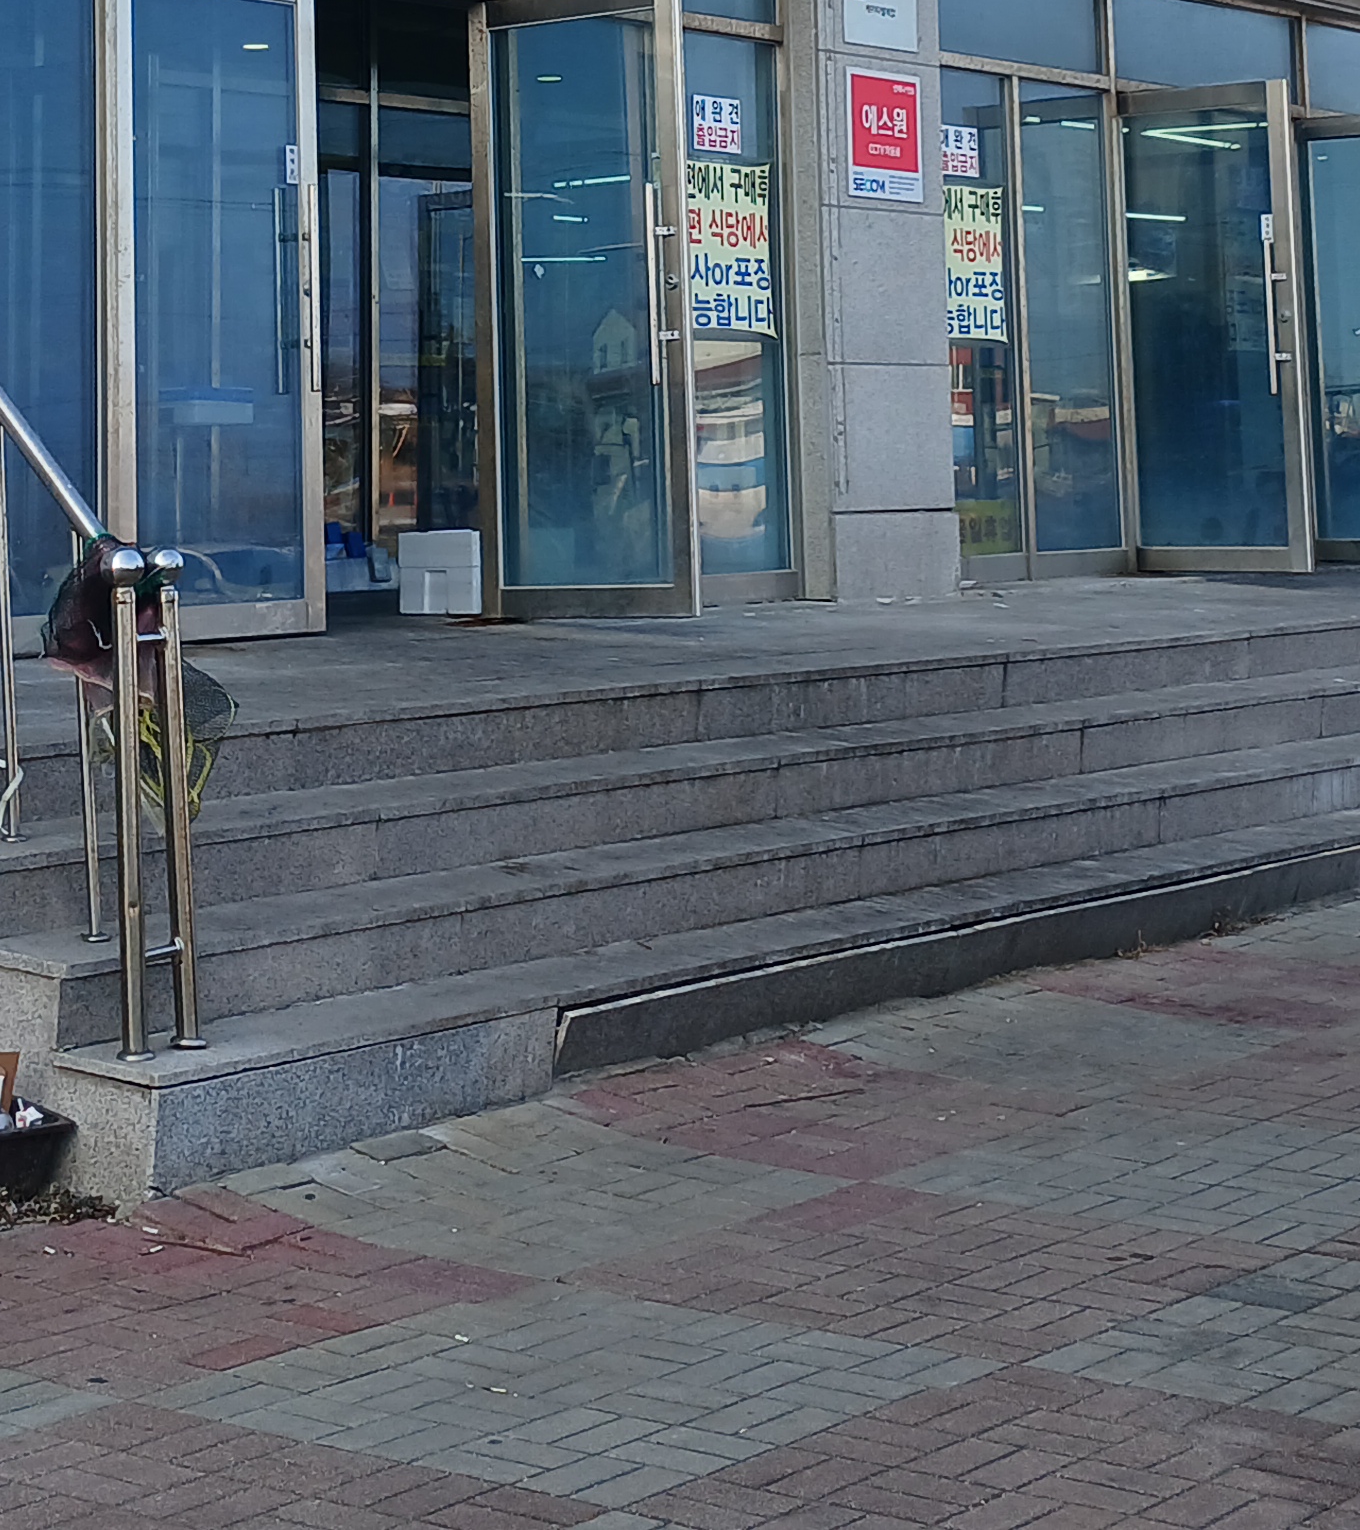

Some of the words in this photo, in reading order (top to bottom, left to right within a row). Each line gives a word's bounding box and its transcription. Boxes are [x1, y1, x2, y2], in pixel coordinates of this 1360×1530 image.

[696, 123, 740, 150] 출입금지
[862, 104, 908, 139] 에스원
[853, 177, 886, 194] SECOM
[692, 293, 774, 330] 능합니다
